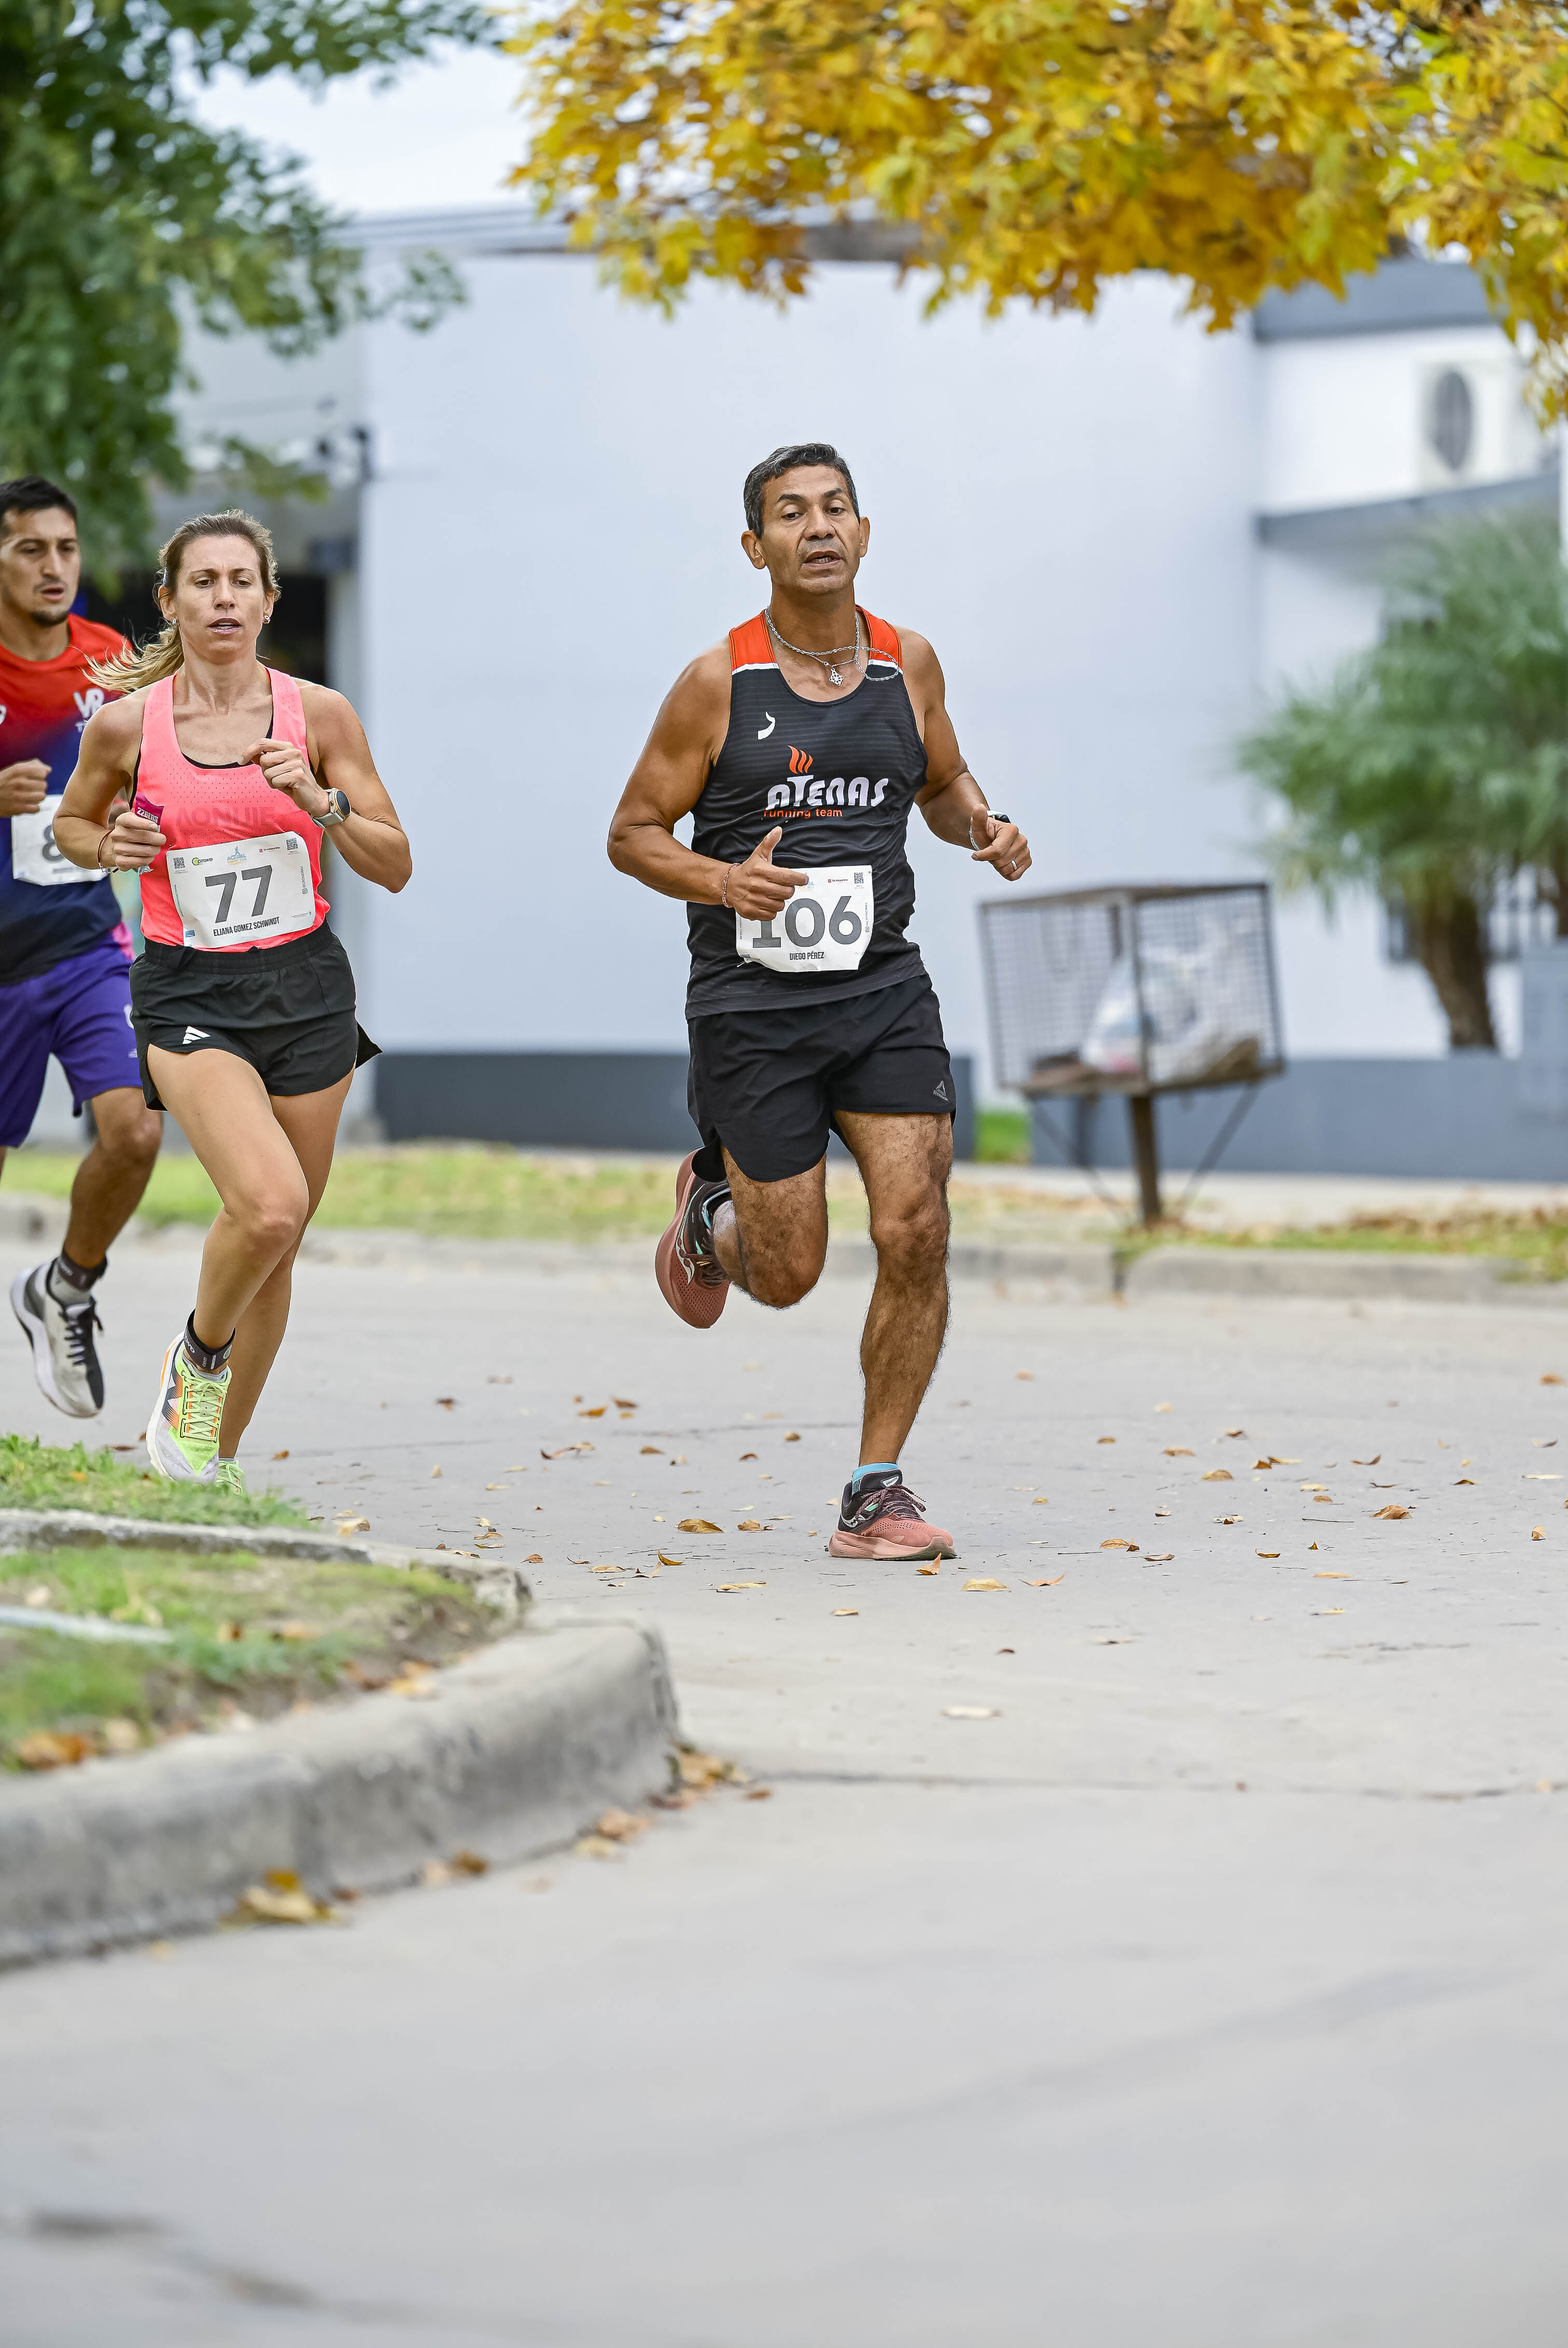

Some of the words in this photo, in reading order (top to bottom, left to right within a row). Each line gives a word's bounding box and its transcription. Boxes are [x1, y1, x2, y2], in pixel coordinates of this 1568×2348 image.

[764, 809, 811, 819] running
[816, 808, 843, 817] team
[205, 865, 273, 924] 77
[213, 926, 233, 937] ELIANA
[234, 923, 253, 933] GOMEZ
[253, 917, 280, 930] SCHWINDT
[753, 896, 862, 948] 106
[790, 952, 806, 960] DIEGO
[807, 951, 824, 960] PÉREZ
